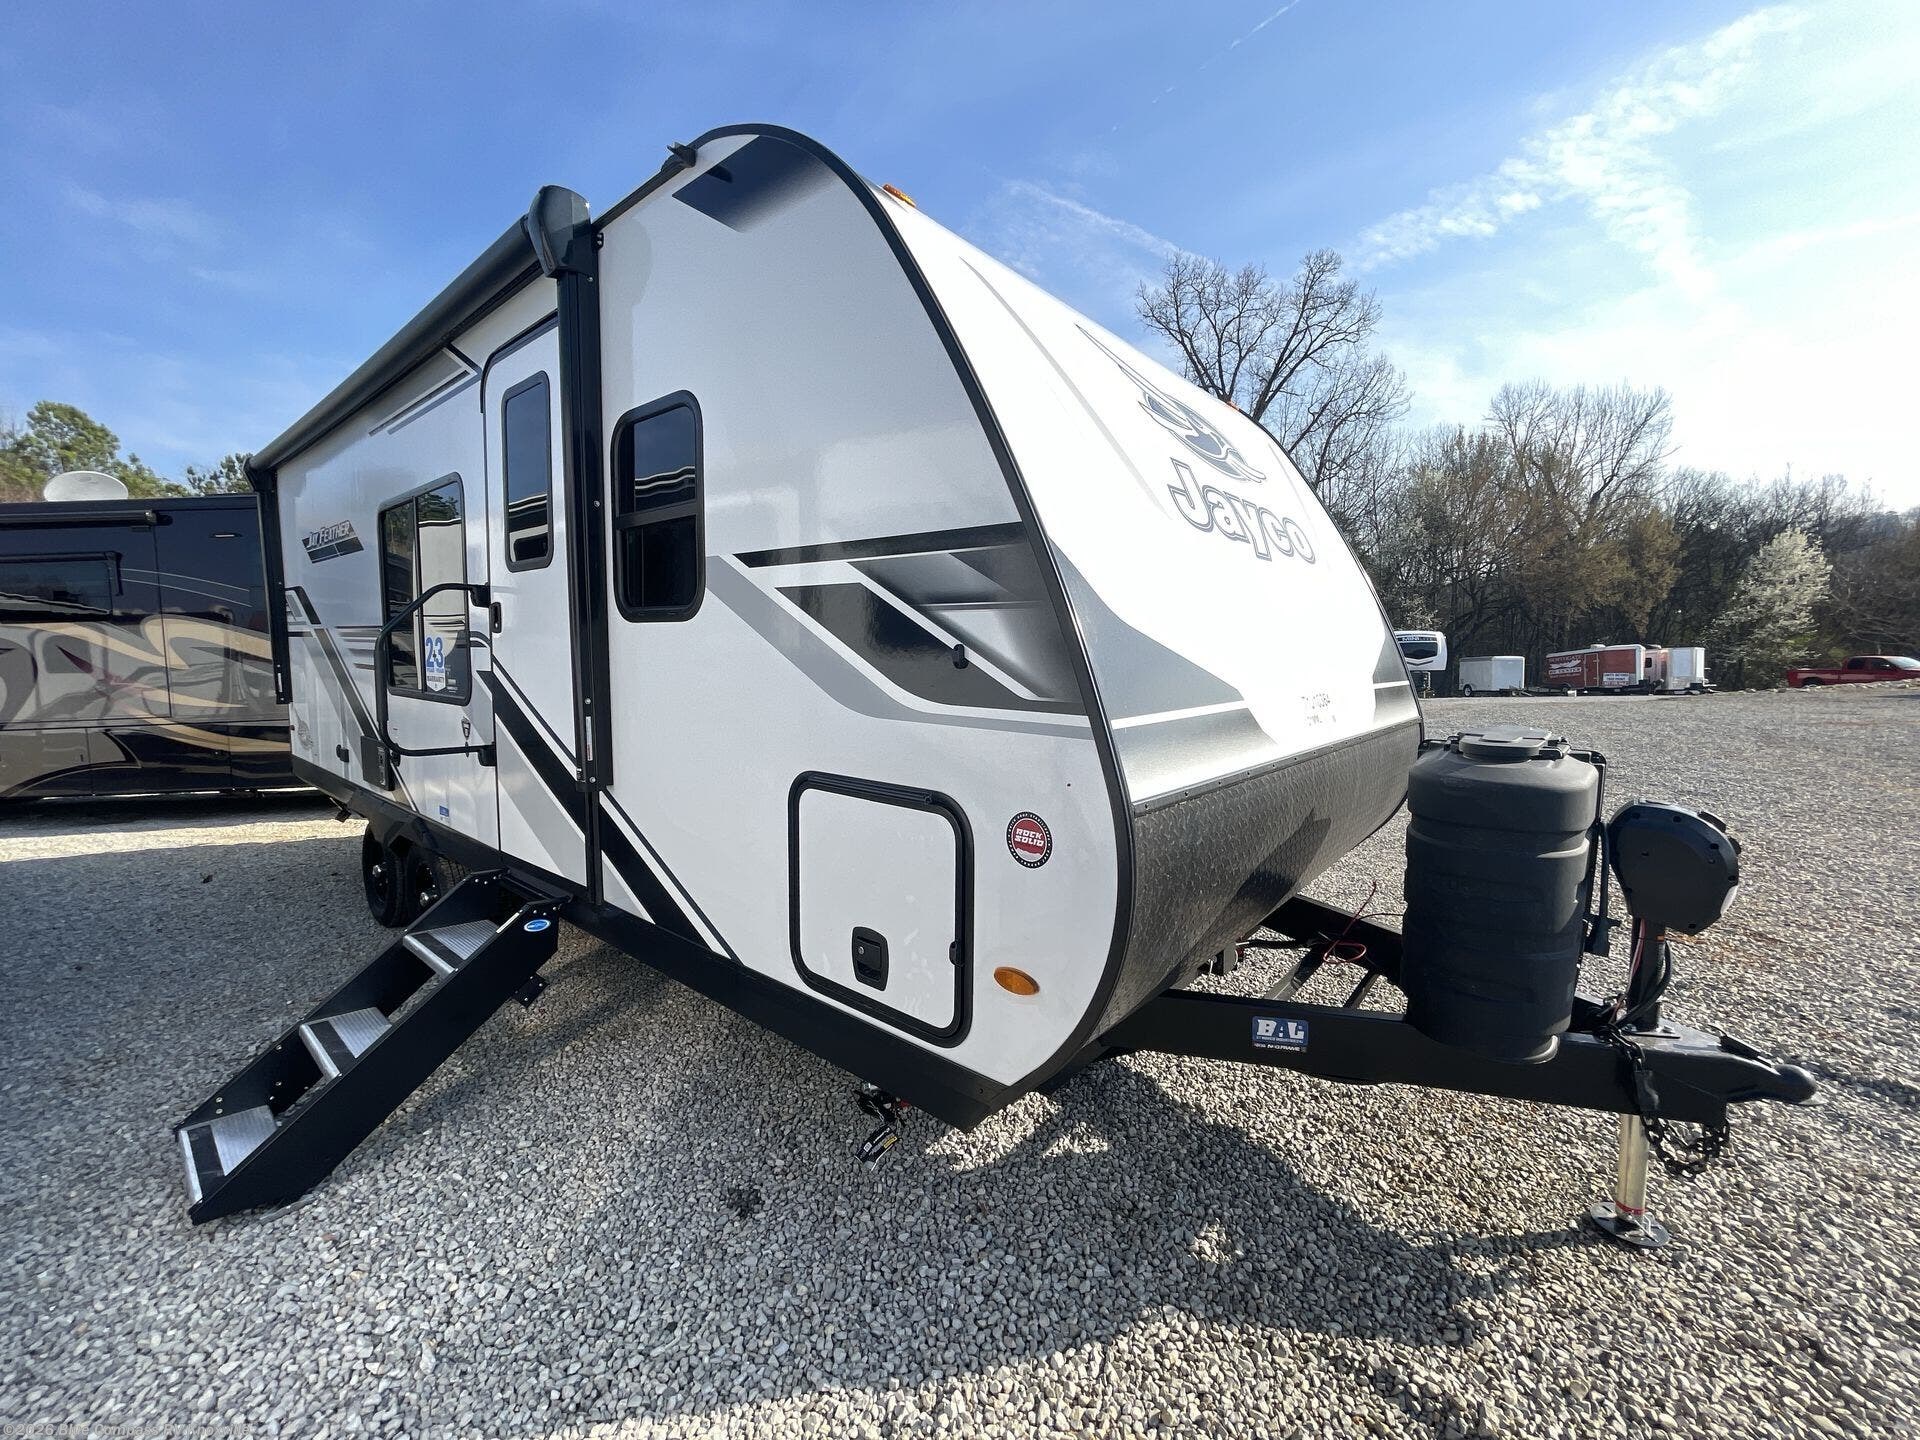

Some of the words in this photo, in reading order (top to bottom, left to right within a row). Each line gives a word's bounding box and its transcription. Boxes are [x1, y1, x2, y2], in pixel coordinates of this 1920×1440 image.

[1167, 457, 1315, 564] Jayco
[1016, 828, 1043, 840] ROCK
[1014, 835, 1044, 847] SOLID
